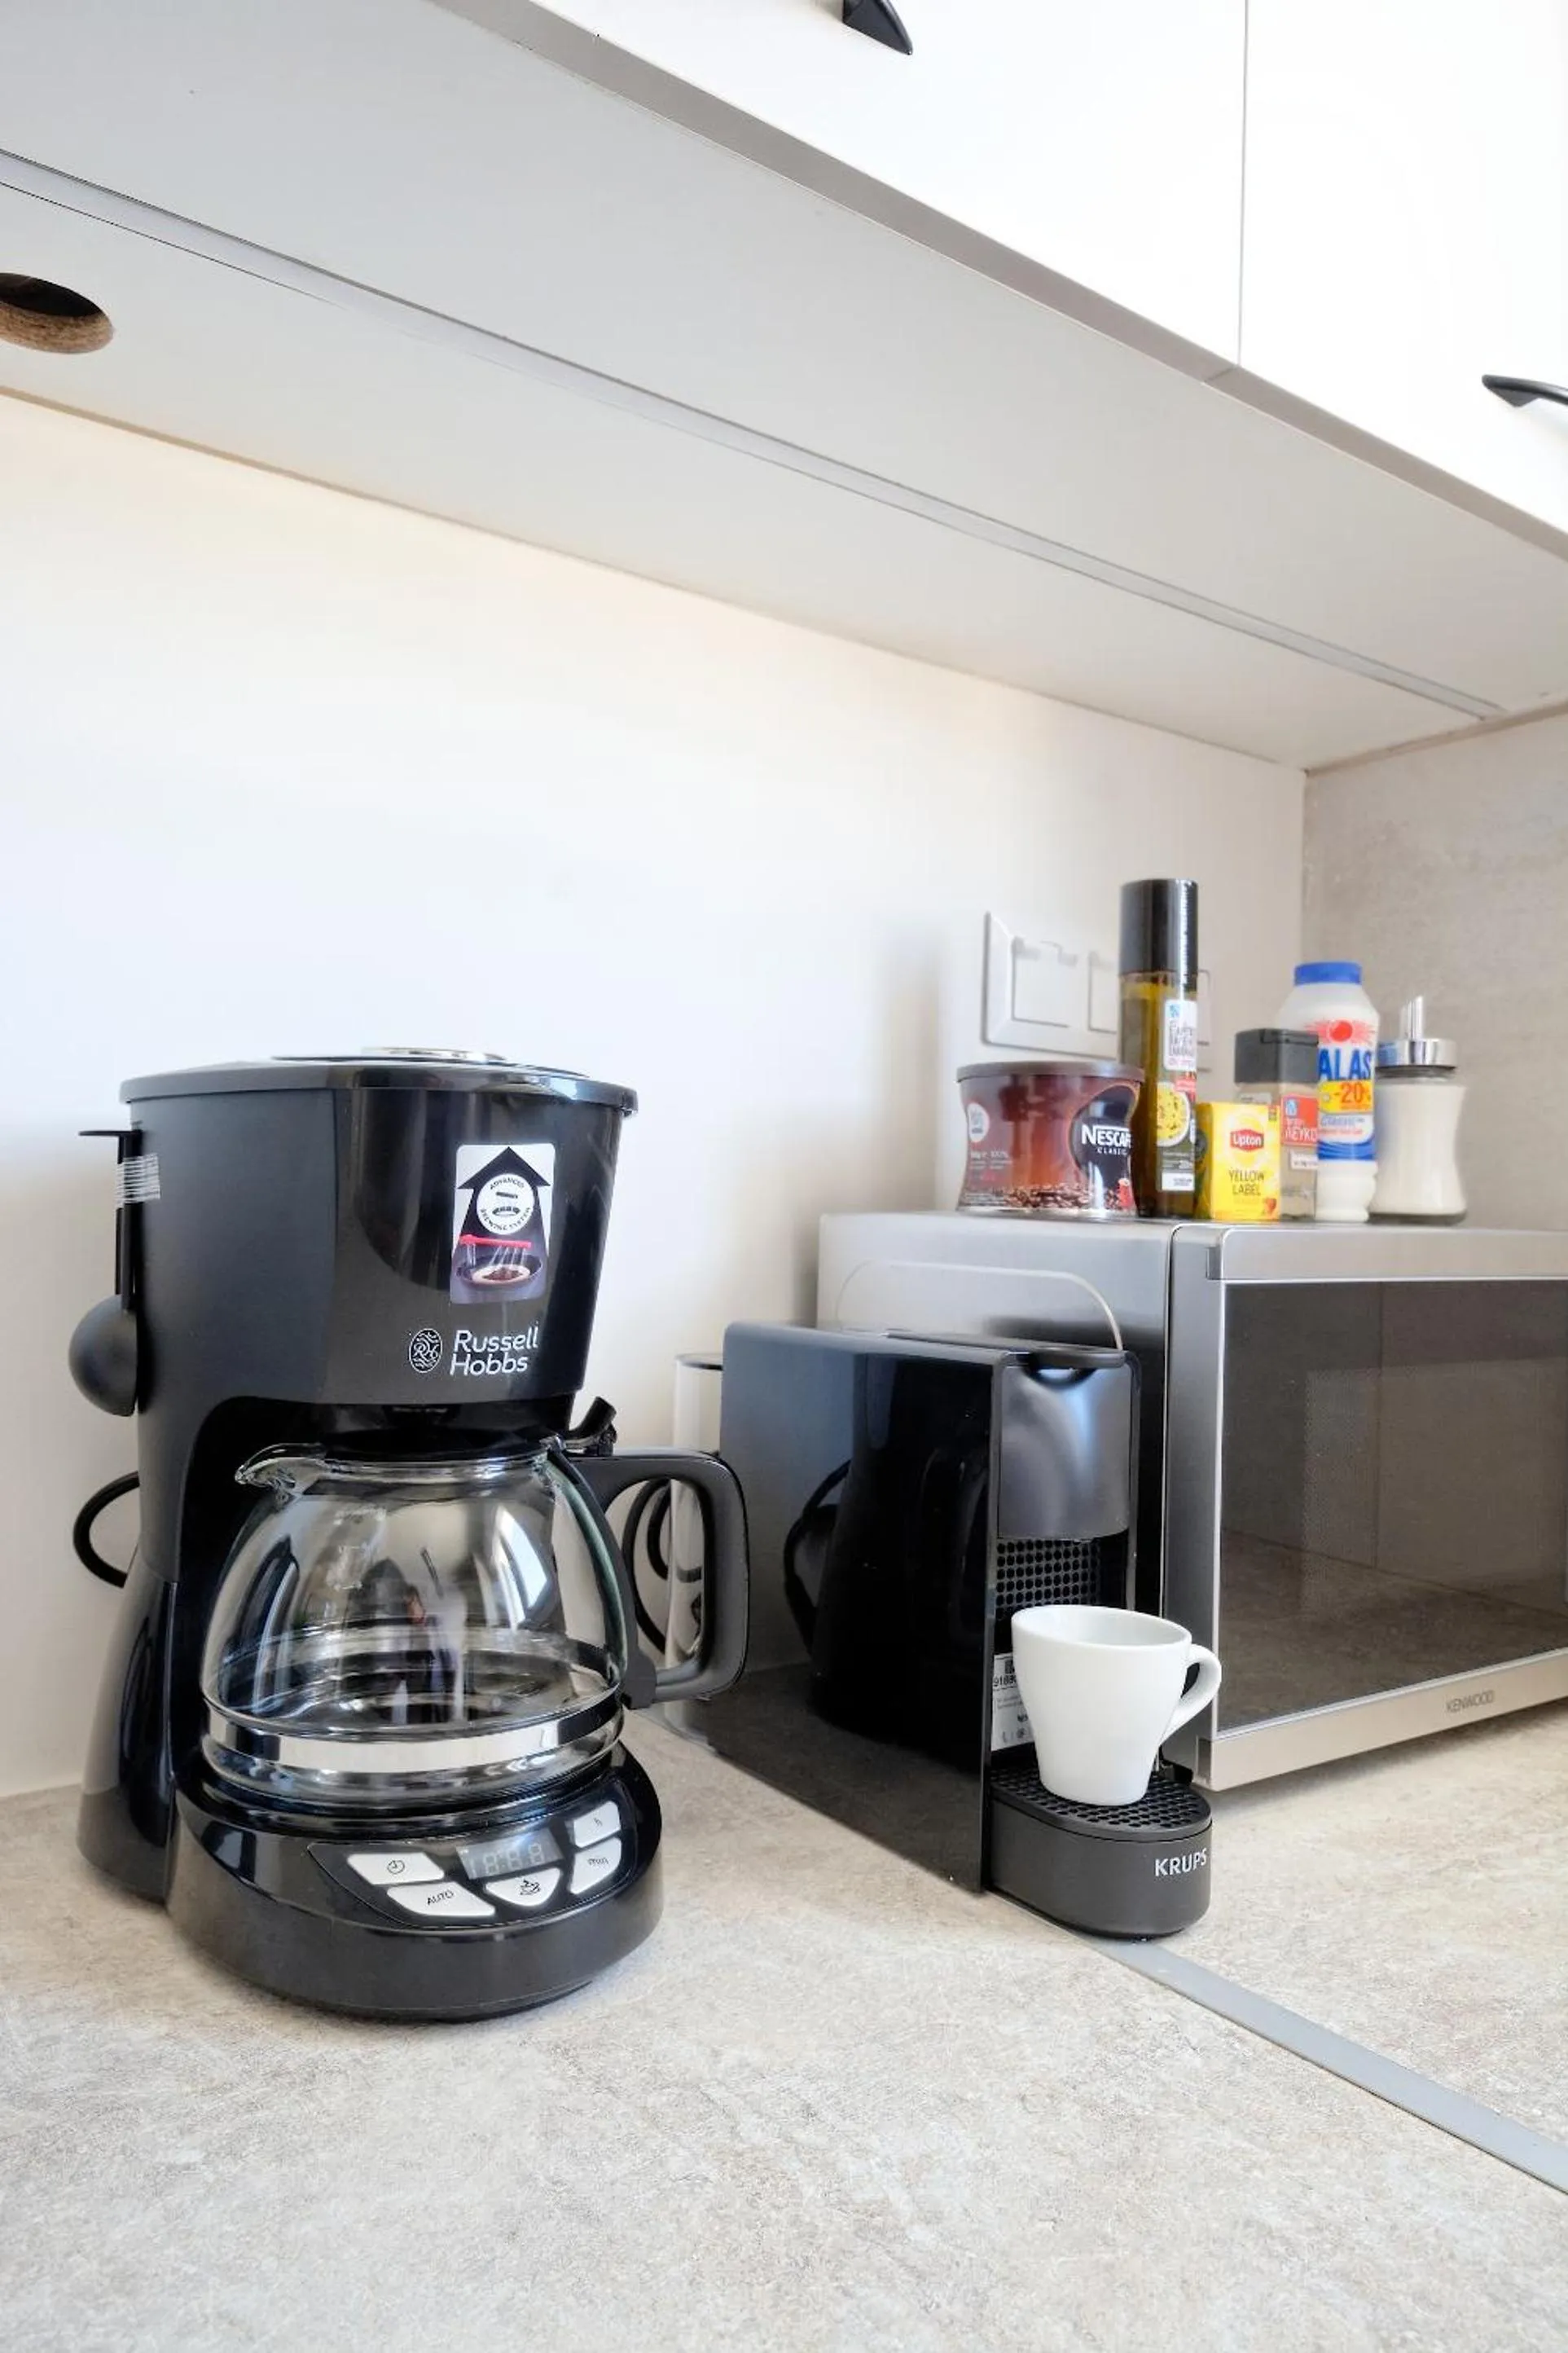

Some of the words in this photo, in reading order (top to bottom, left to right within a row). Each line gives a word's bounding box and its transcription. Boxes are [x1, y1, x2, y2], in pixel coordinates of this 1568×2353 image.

[1318, 1048, 1372, 1082] ALAS
[1081, 1124, 1131, 1149] NESCAF
[1233, 1133, 1262, 1147] Lipton
[1228, 1169, 1265, 1182] YELLOW
[1232, 1184, 1261, 1196] LABEL
[455, 1326, 538, 1352] Russell
[450, 1352, 528, 1375] Hobbs
[1155, 1848, 1207, 1877] KRUPS
[428, 1889, 454, 1905] AUTO
